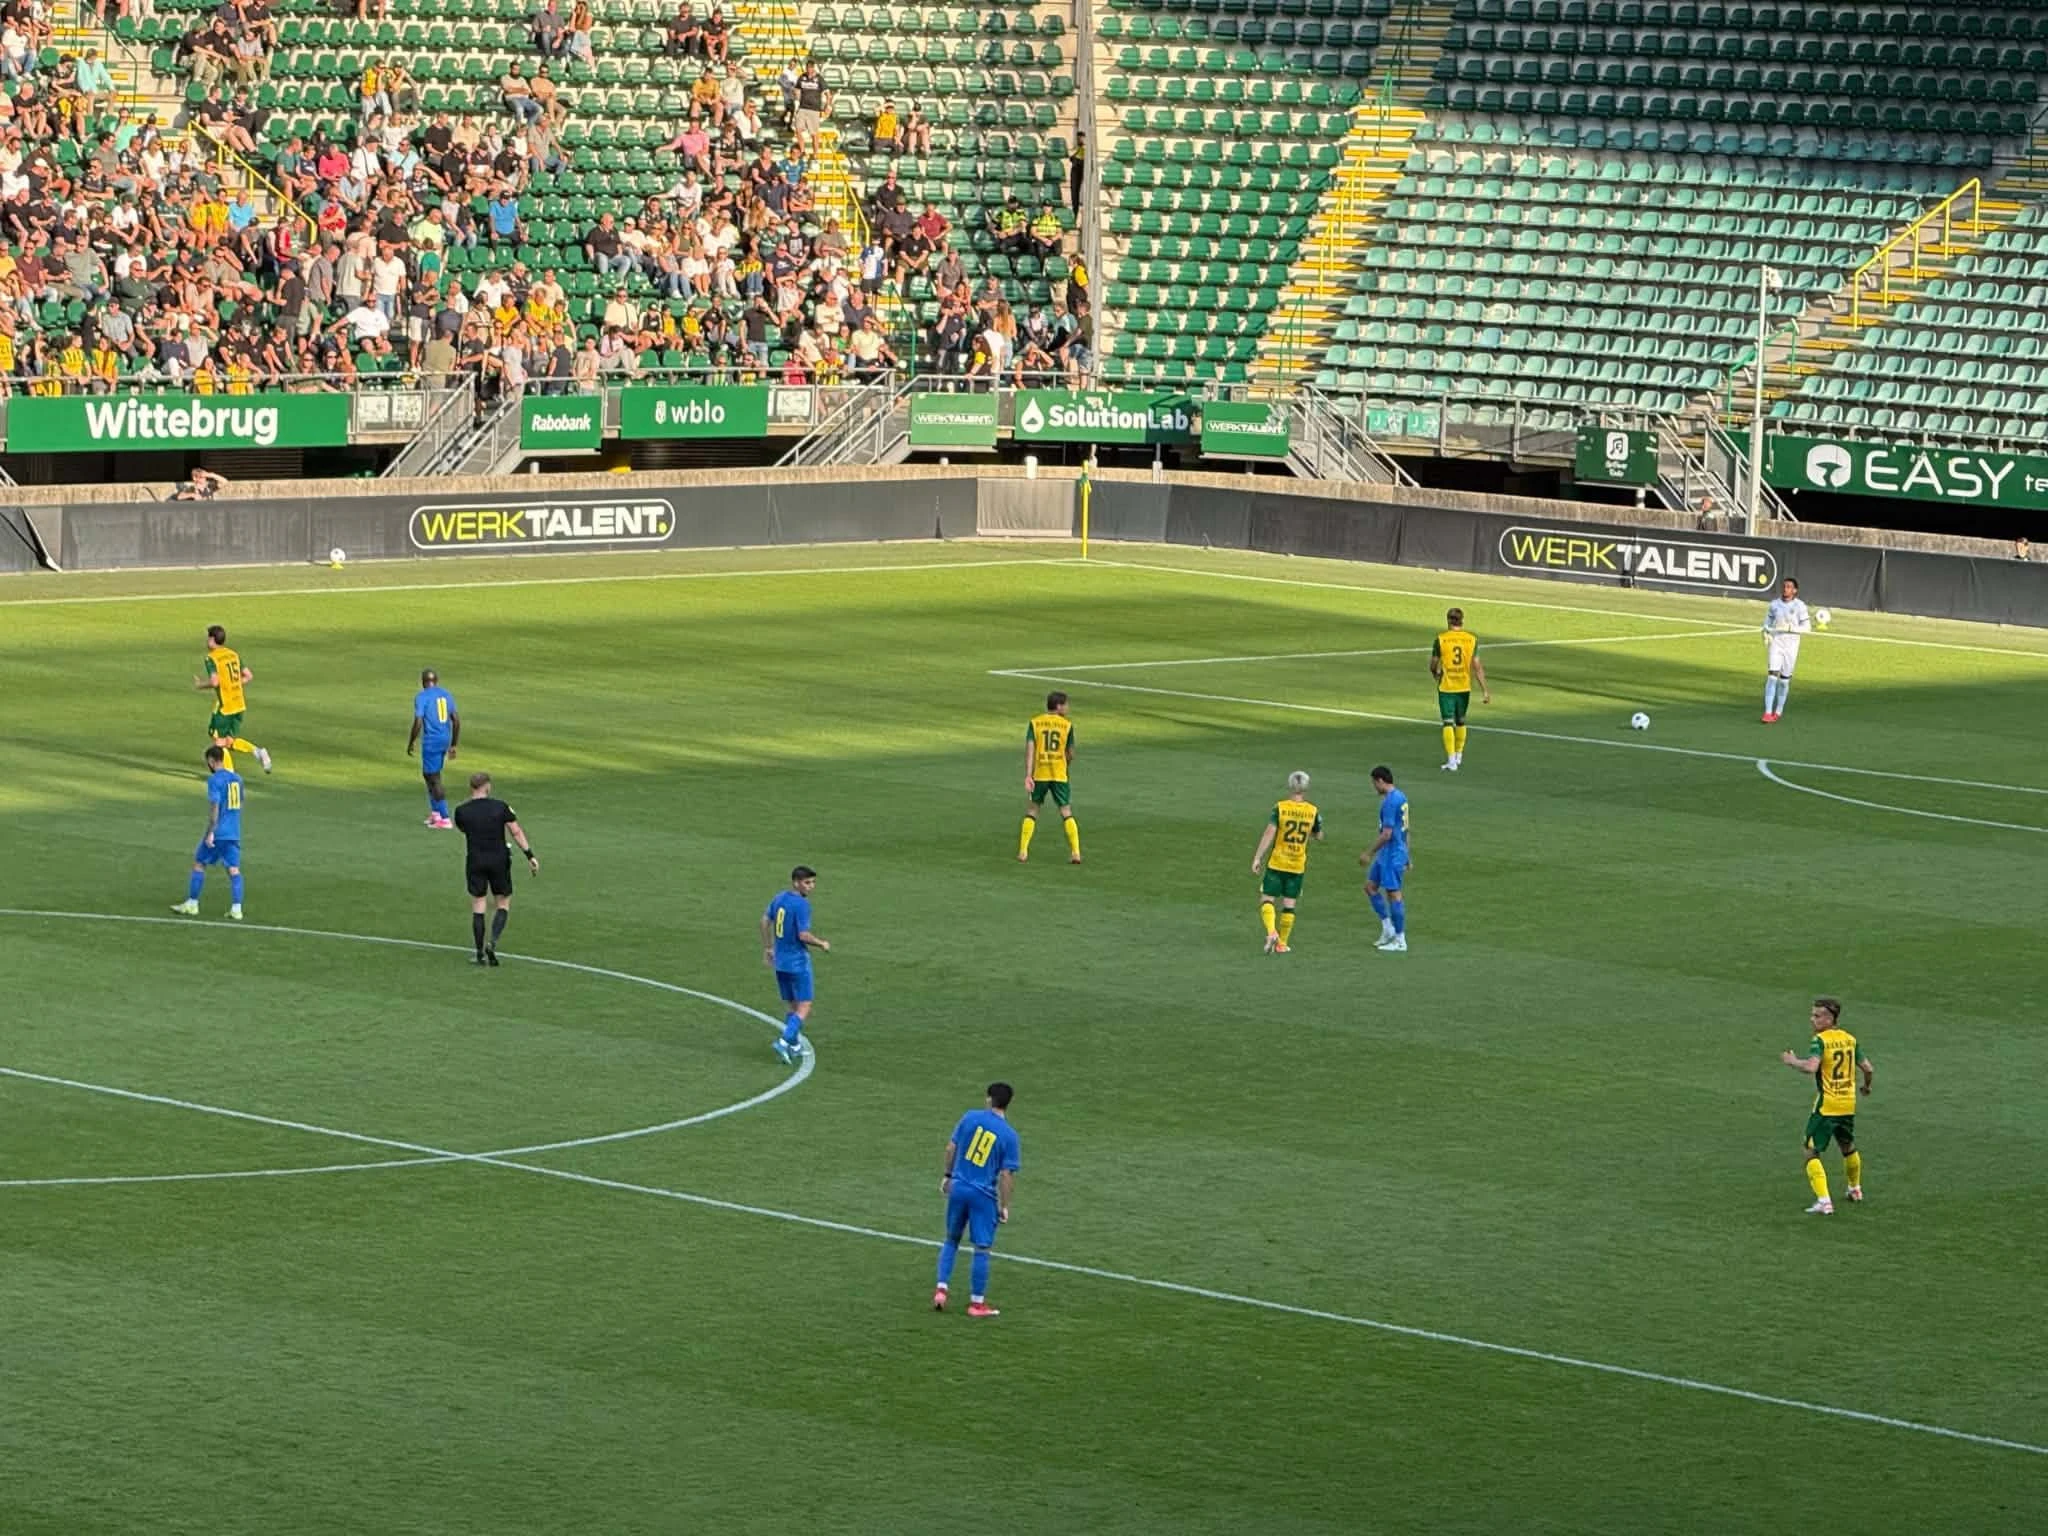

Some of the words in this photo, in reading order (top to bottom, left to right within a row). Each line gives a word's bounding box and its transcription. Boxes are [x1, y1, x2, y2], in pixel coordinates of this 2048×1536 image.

[85, 399, 278, 445] Wittebrug
[532, 415, 591, 431] Rabobank
[672, 400, 725, 424] wblo
[1049, 405, 1189, 430] SolutionLab
[1865, 450, 2016, 499] EASY
[1452, 646, 1462, 666] 3
[226, 661, 240, 684] 15
[1042, 730, 1061, 752] 16
[227, 781, 241, 809] 10
[1284, 820, 1309, 844] 25
[775, 907, 785, 938] 8
[1832, 1049, 1854, 1080] 21
[965, 1126, 998, 1168] 19
